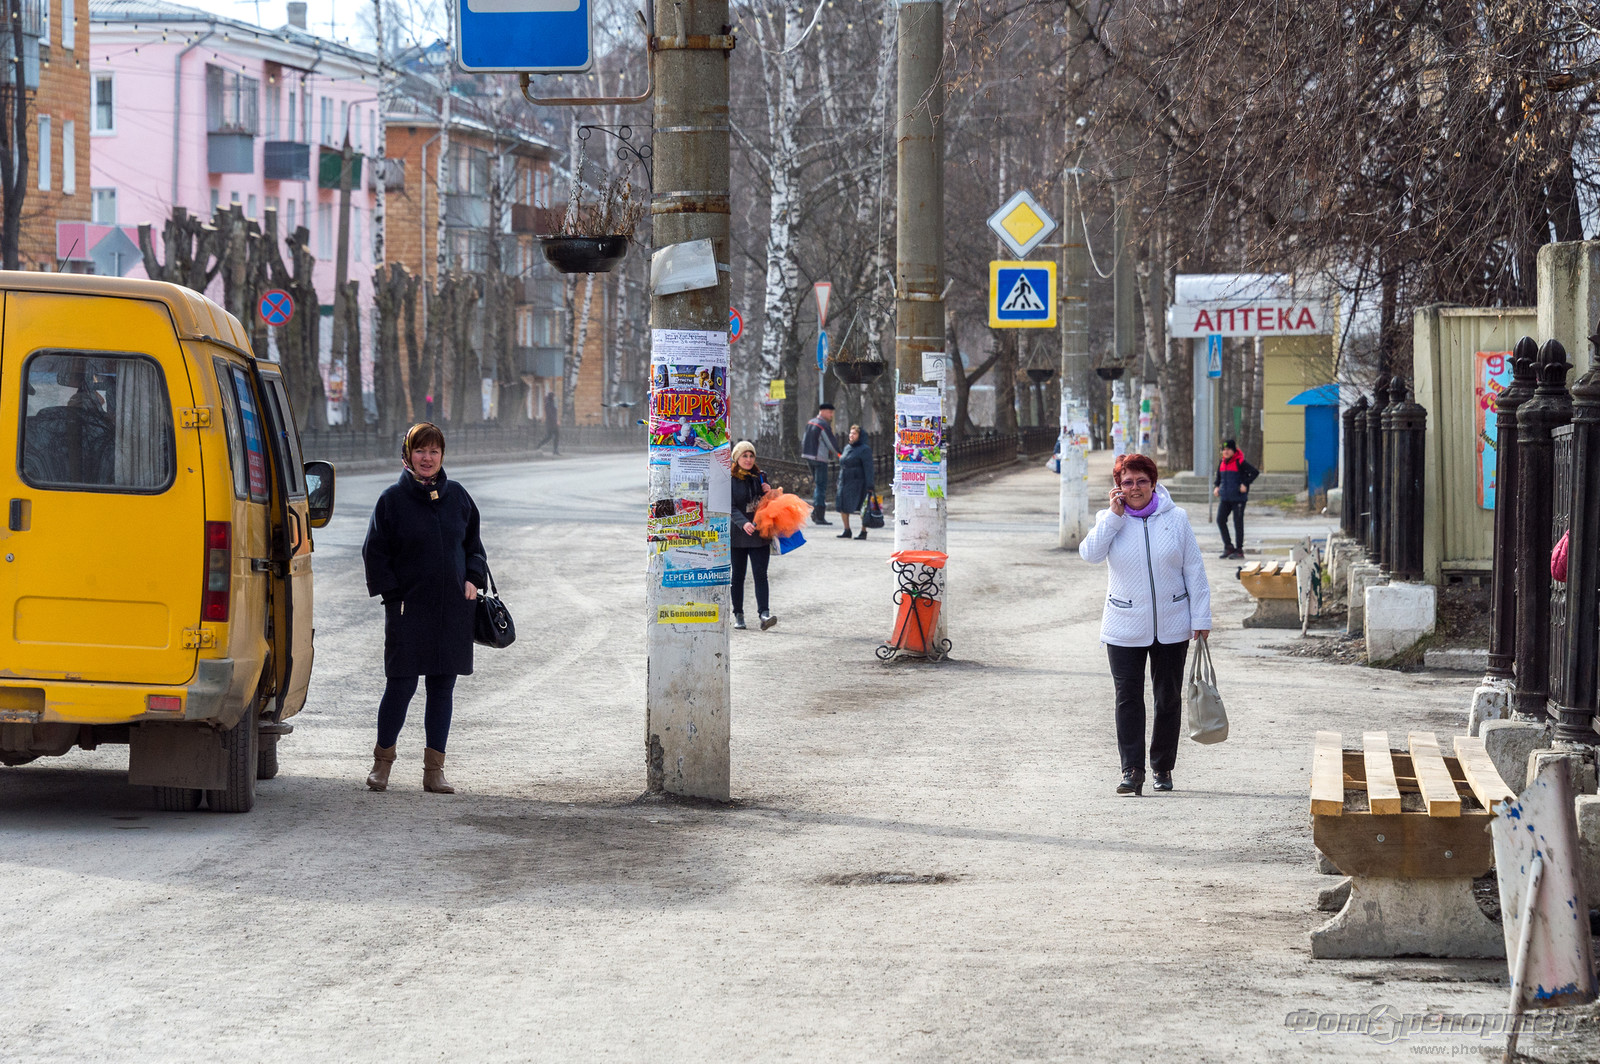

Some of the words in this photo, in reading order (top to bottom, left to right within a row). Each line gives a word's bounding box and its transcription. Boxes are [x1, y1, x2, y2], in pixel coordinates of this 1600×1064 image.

[1193, 307, 1316, 332] АПТЕКА
[1486, 354, 1505, 376] 9
[657, 393, 716, 417] ЦИРК
[900, 430, 934, 446] ЦИРК
[665, 572, 695, 582] СЕРГЕЙ
